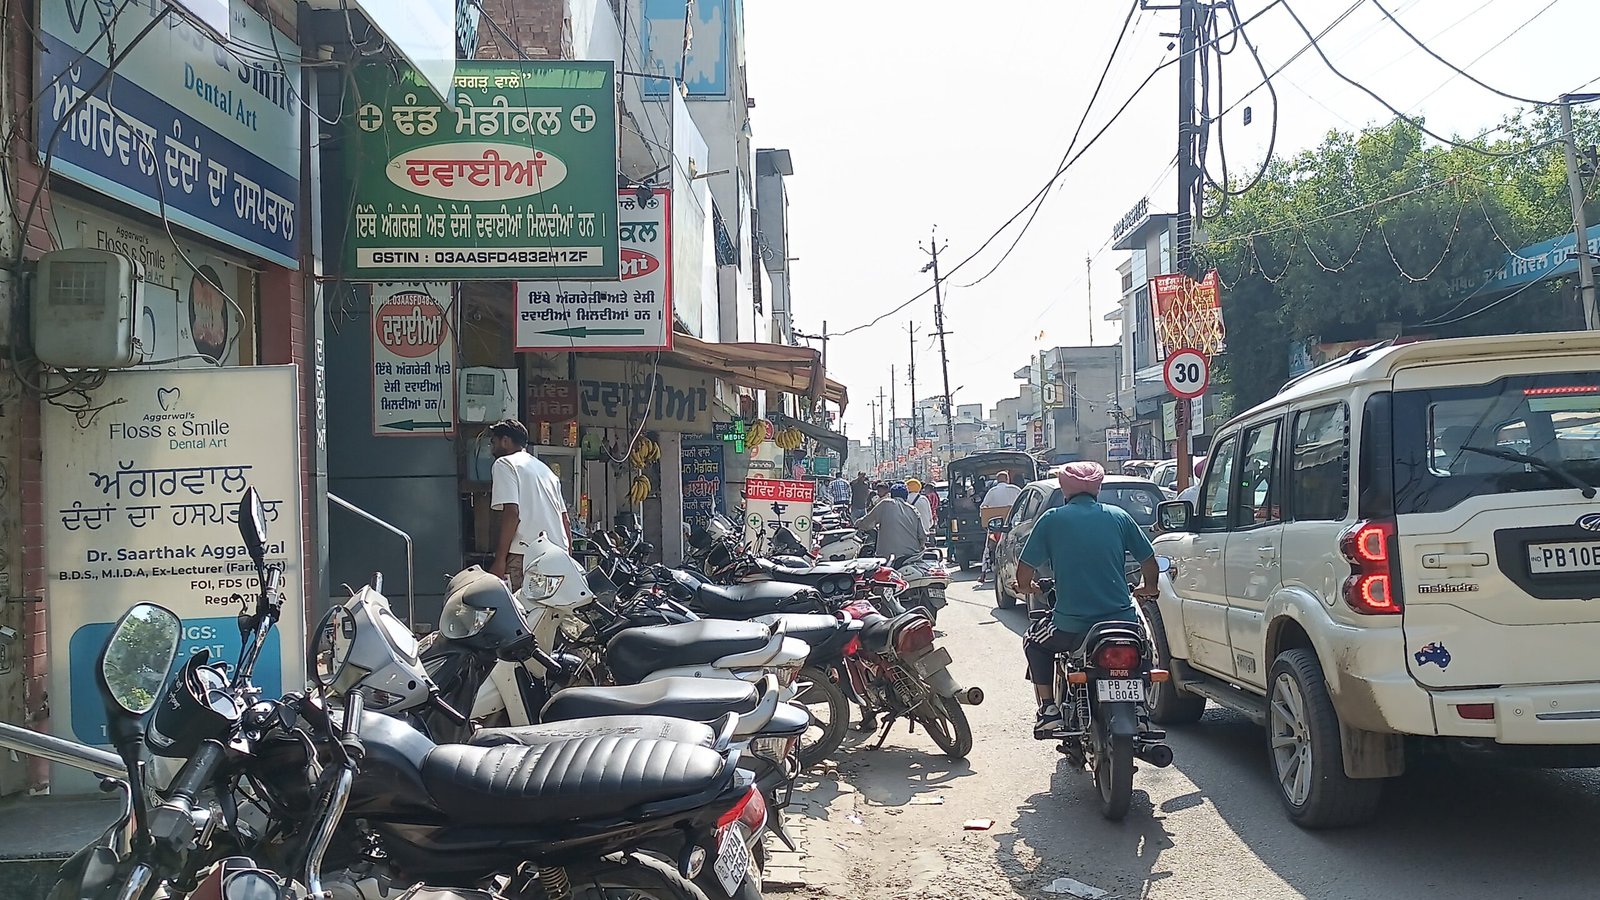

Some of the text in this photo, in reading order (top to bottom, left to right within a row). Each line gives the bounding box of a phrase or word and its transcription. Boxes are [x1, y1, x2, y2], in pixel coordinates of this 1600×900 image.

[184, 61, 257, 132] Dental Art
[453, 91, 564, 137] ਮੈਡੀਕਲ
[52, 60, 295, 242] ਅੱਗਰਵਾਲ ਦੰਦਾਂ ਦਾ ਹਸਪਤਾਲ
[405, 148, 548, 188] ਦਵਾਈਆਂ
[355, 203, 377, 239] ਇੱਥੇ
[426, 204, 447, 239] ਅਤੇ
[450, 203, 472, 239] ਦੇਸੀ
[475, 203, 523, 239] ਦਵਾਈਆਂ
[526, 203, 574, 239] ਮਿਲਦੀਆਂ
[578, 212, 595, 239] ਹਨ
[97, 229, 130, 256] Floss
[139, 244, 166, 271] Smile
[372, 251, 420, 264] GSTIN
[434, 250, 589, 264] 03AASFD4832H1ZF
[633, 289, 655, 304] ਦੇਸੀ
[520, 308, 571, 321] ਦਵਾਈਆਂ
[576, 308, 629, 321] ਮਿਲਦੀਆਂ
[634, 310, 651, 321] ਹਨ
[1174, 363, 1200, 384] 30
[384, 379, 443, 393] ਦੇਸੀ ਦਵਾਈਆ
[381, 397, 421, 410] ਮਿਲਦੀਆਂ
[425, 399, 438, 410] ਹਨ
[579, 373, 708, 423] ਦਵਾਈਆਂ
[143, 411, 195, 422] Aggarwal's
[109, 418, 230, 440] Floss & Smile
[169, 437, 228, 450] Dental Art
[88, 459, 253, 500] ਅੱਗਰਵਾਲ
[59, 500, 284, 532] ਦੰਦਾਂ ਦਾ ਹਸਪਤਲ
[86, 540, 286, 563] Dr. Saarthak Aggaal
[59, 569, 99, 582] B.D.S.,
[152, 564, 223, 577] Ex-Lecturer
[190, 576, 287, 592] FOI, FDS (Di)
[1418, 582, 1480, 594] mahindra
[1107, 680, 1121, 690] PB
[1126, 680, 1139, 690] 29
[1109, 690, 1140, 700] L8045
